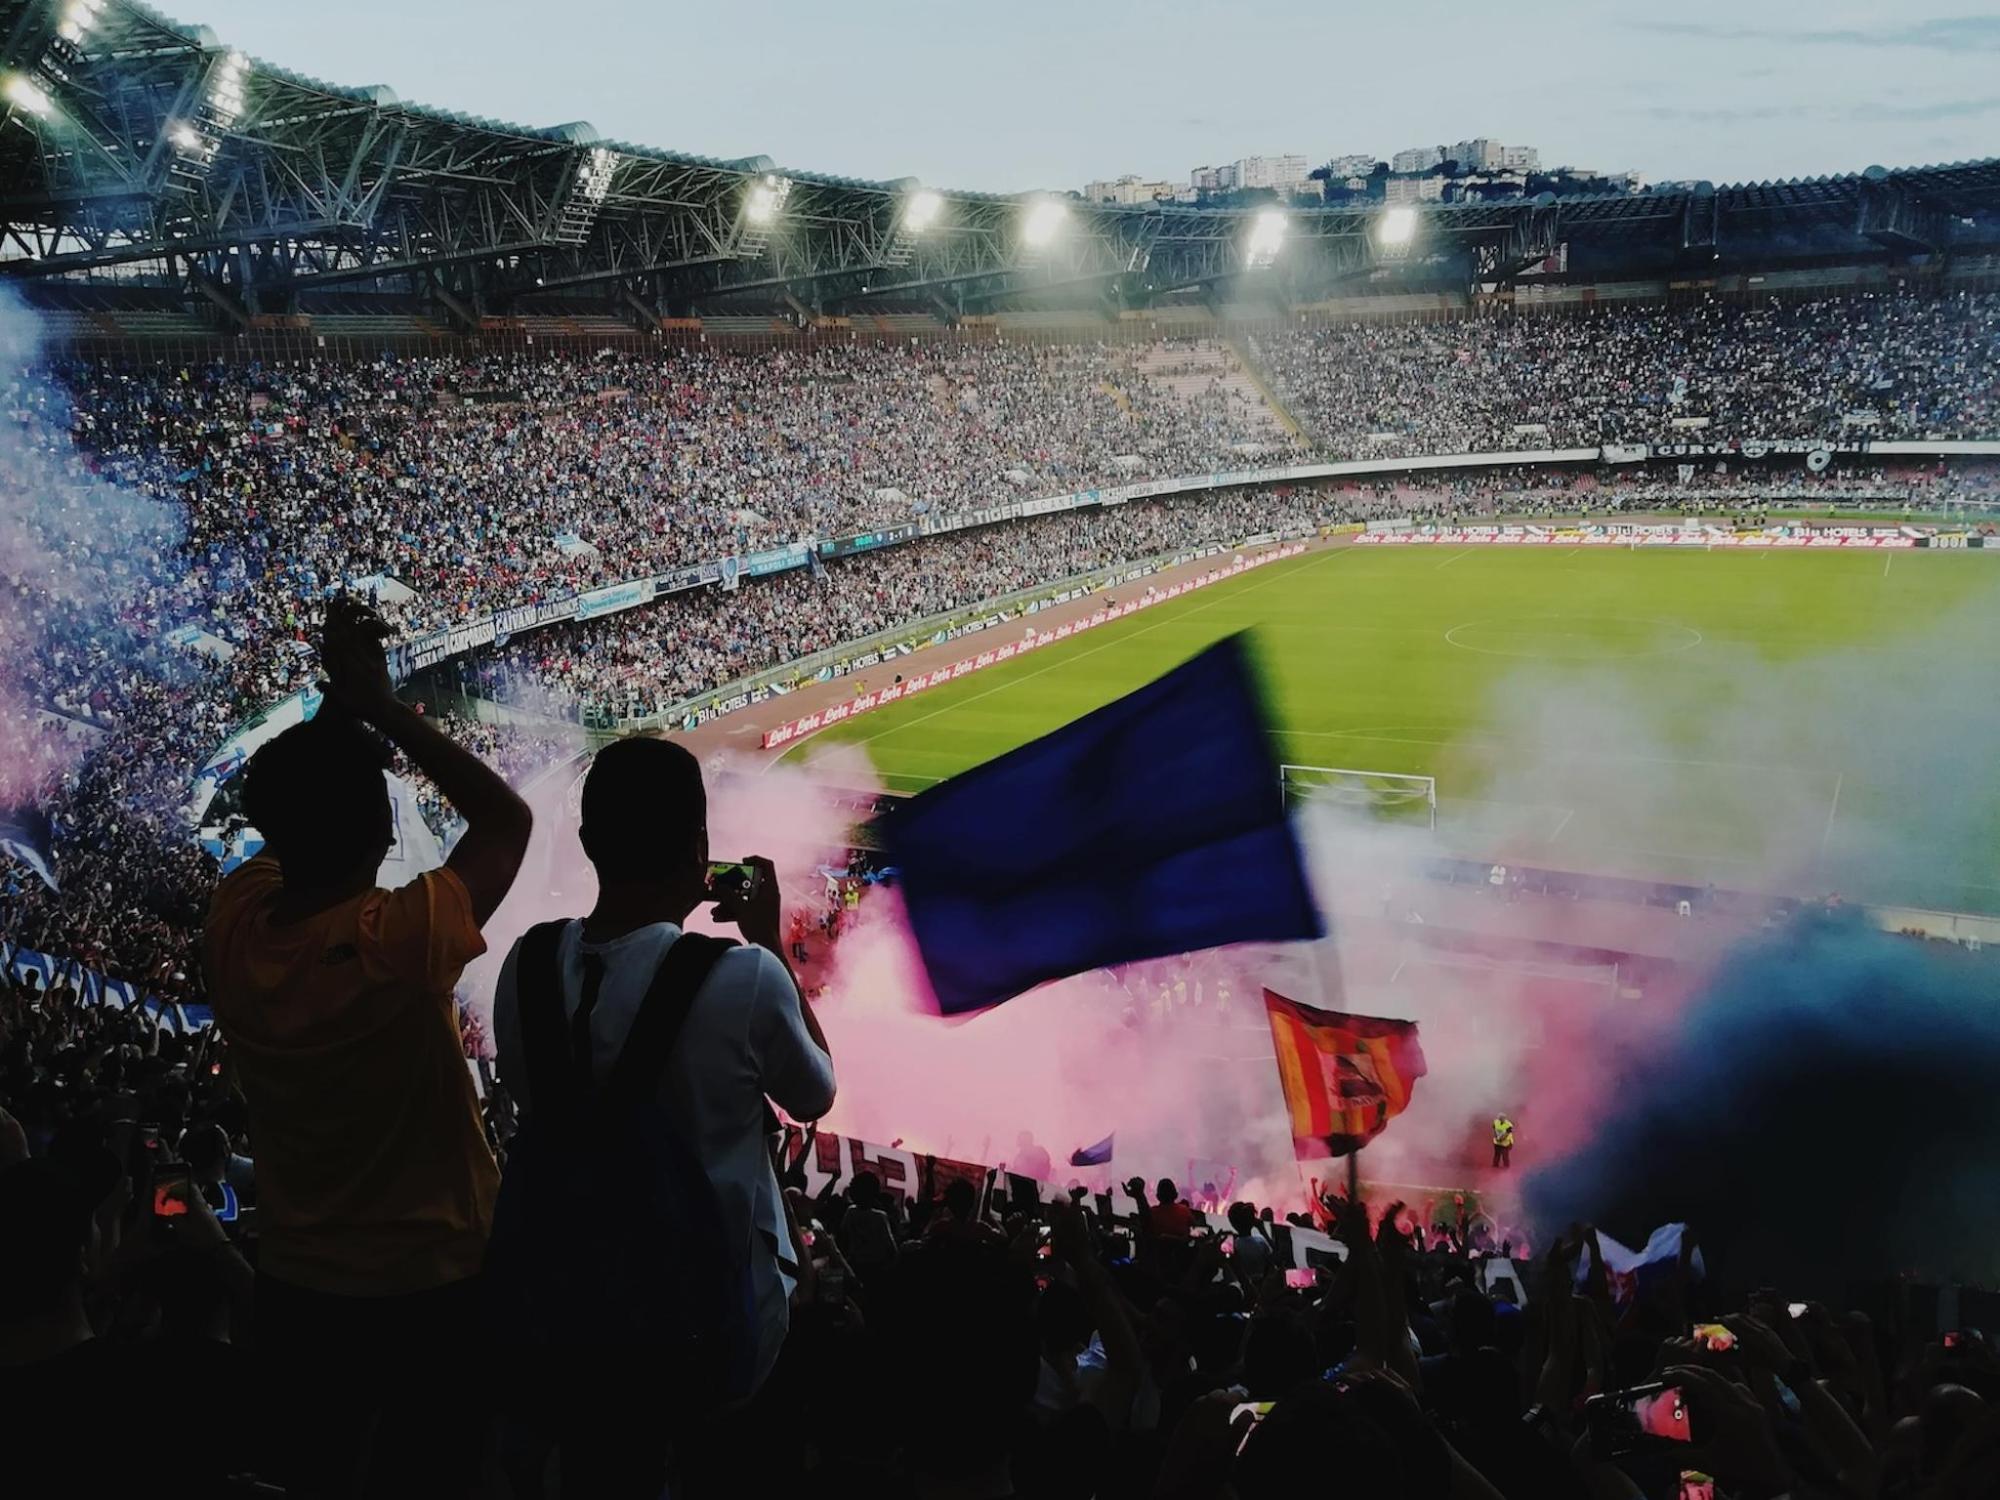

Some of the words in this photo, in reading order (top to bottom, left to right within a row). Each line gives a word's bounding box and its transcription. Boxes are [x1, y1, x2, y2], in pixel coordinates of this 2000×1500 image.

[973, 503, 1022, 527] TIGER
[1824, 527, 1868, 537] HOTELS
[852, 652, 879, 672] HOTELS
[699, 708, 716, 723] Blu
[718, 694, 748, 717] HOTELS
[767, 727, 792, 748] Lete
[794, 715, 820, 735] Lete
[822, 705, 848, 725] Lete
[851, 695, 876, 714] Lete
[878, 686, 902, 704] Lete
[903, 677, 926, 695] Lete
[929, 668, 951, 686] Lete
[953, 660, 973, 677] Lete
[974, 652, 994, 669] Lete
[996, 645, 1015, 661] Lete
